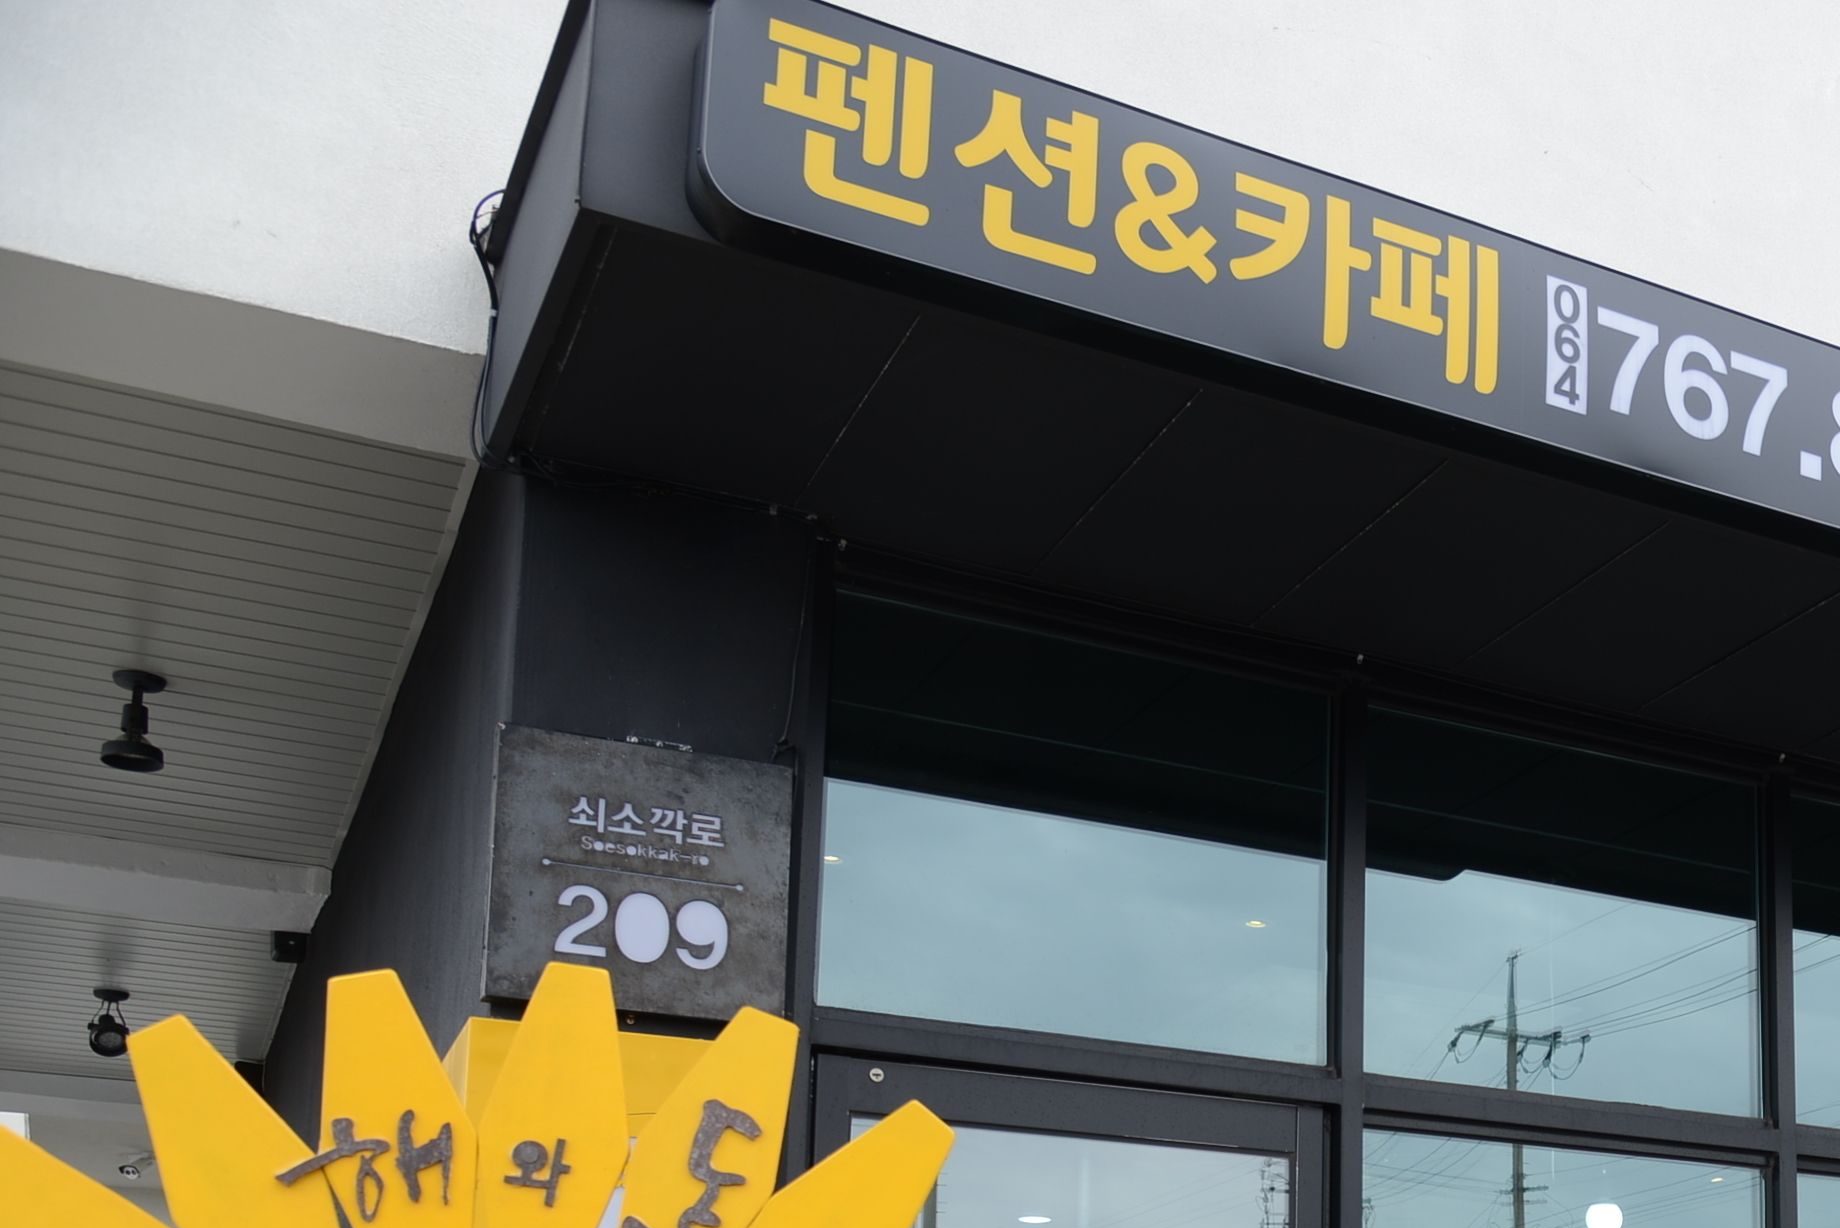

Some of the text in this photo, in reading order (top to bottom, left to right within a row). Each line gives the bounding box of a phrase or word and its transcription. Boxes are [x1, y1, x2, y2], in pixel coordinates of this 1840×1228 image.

[763, 17, 1499, 395] 펜션&카페
[568, 796, 724, 847] 쇠소깍로
[580, 835, 709, 866] Soesokkak-ro
[554, 884, 728, 970] 209
